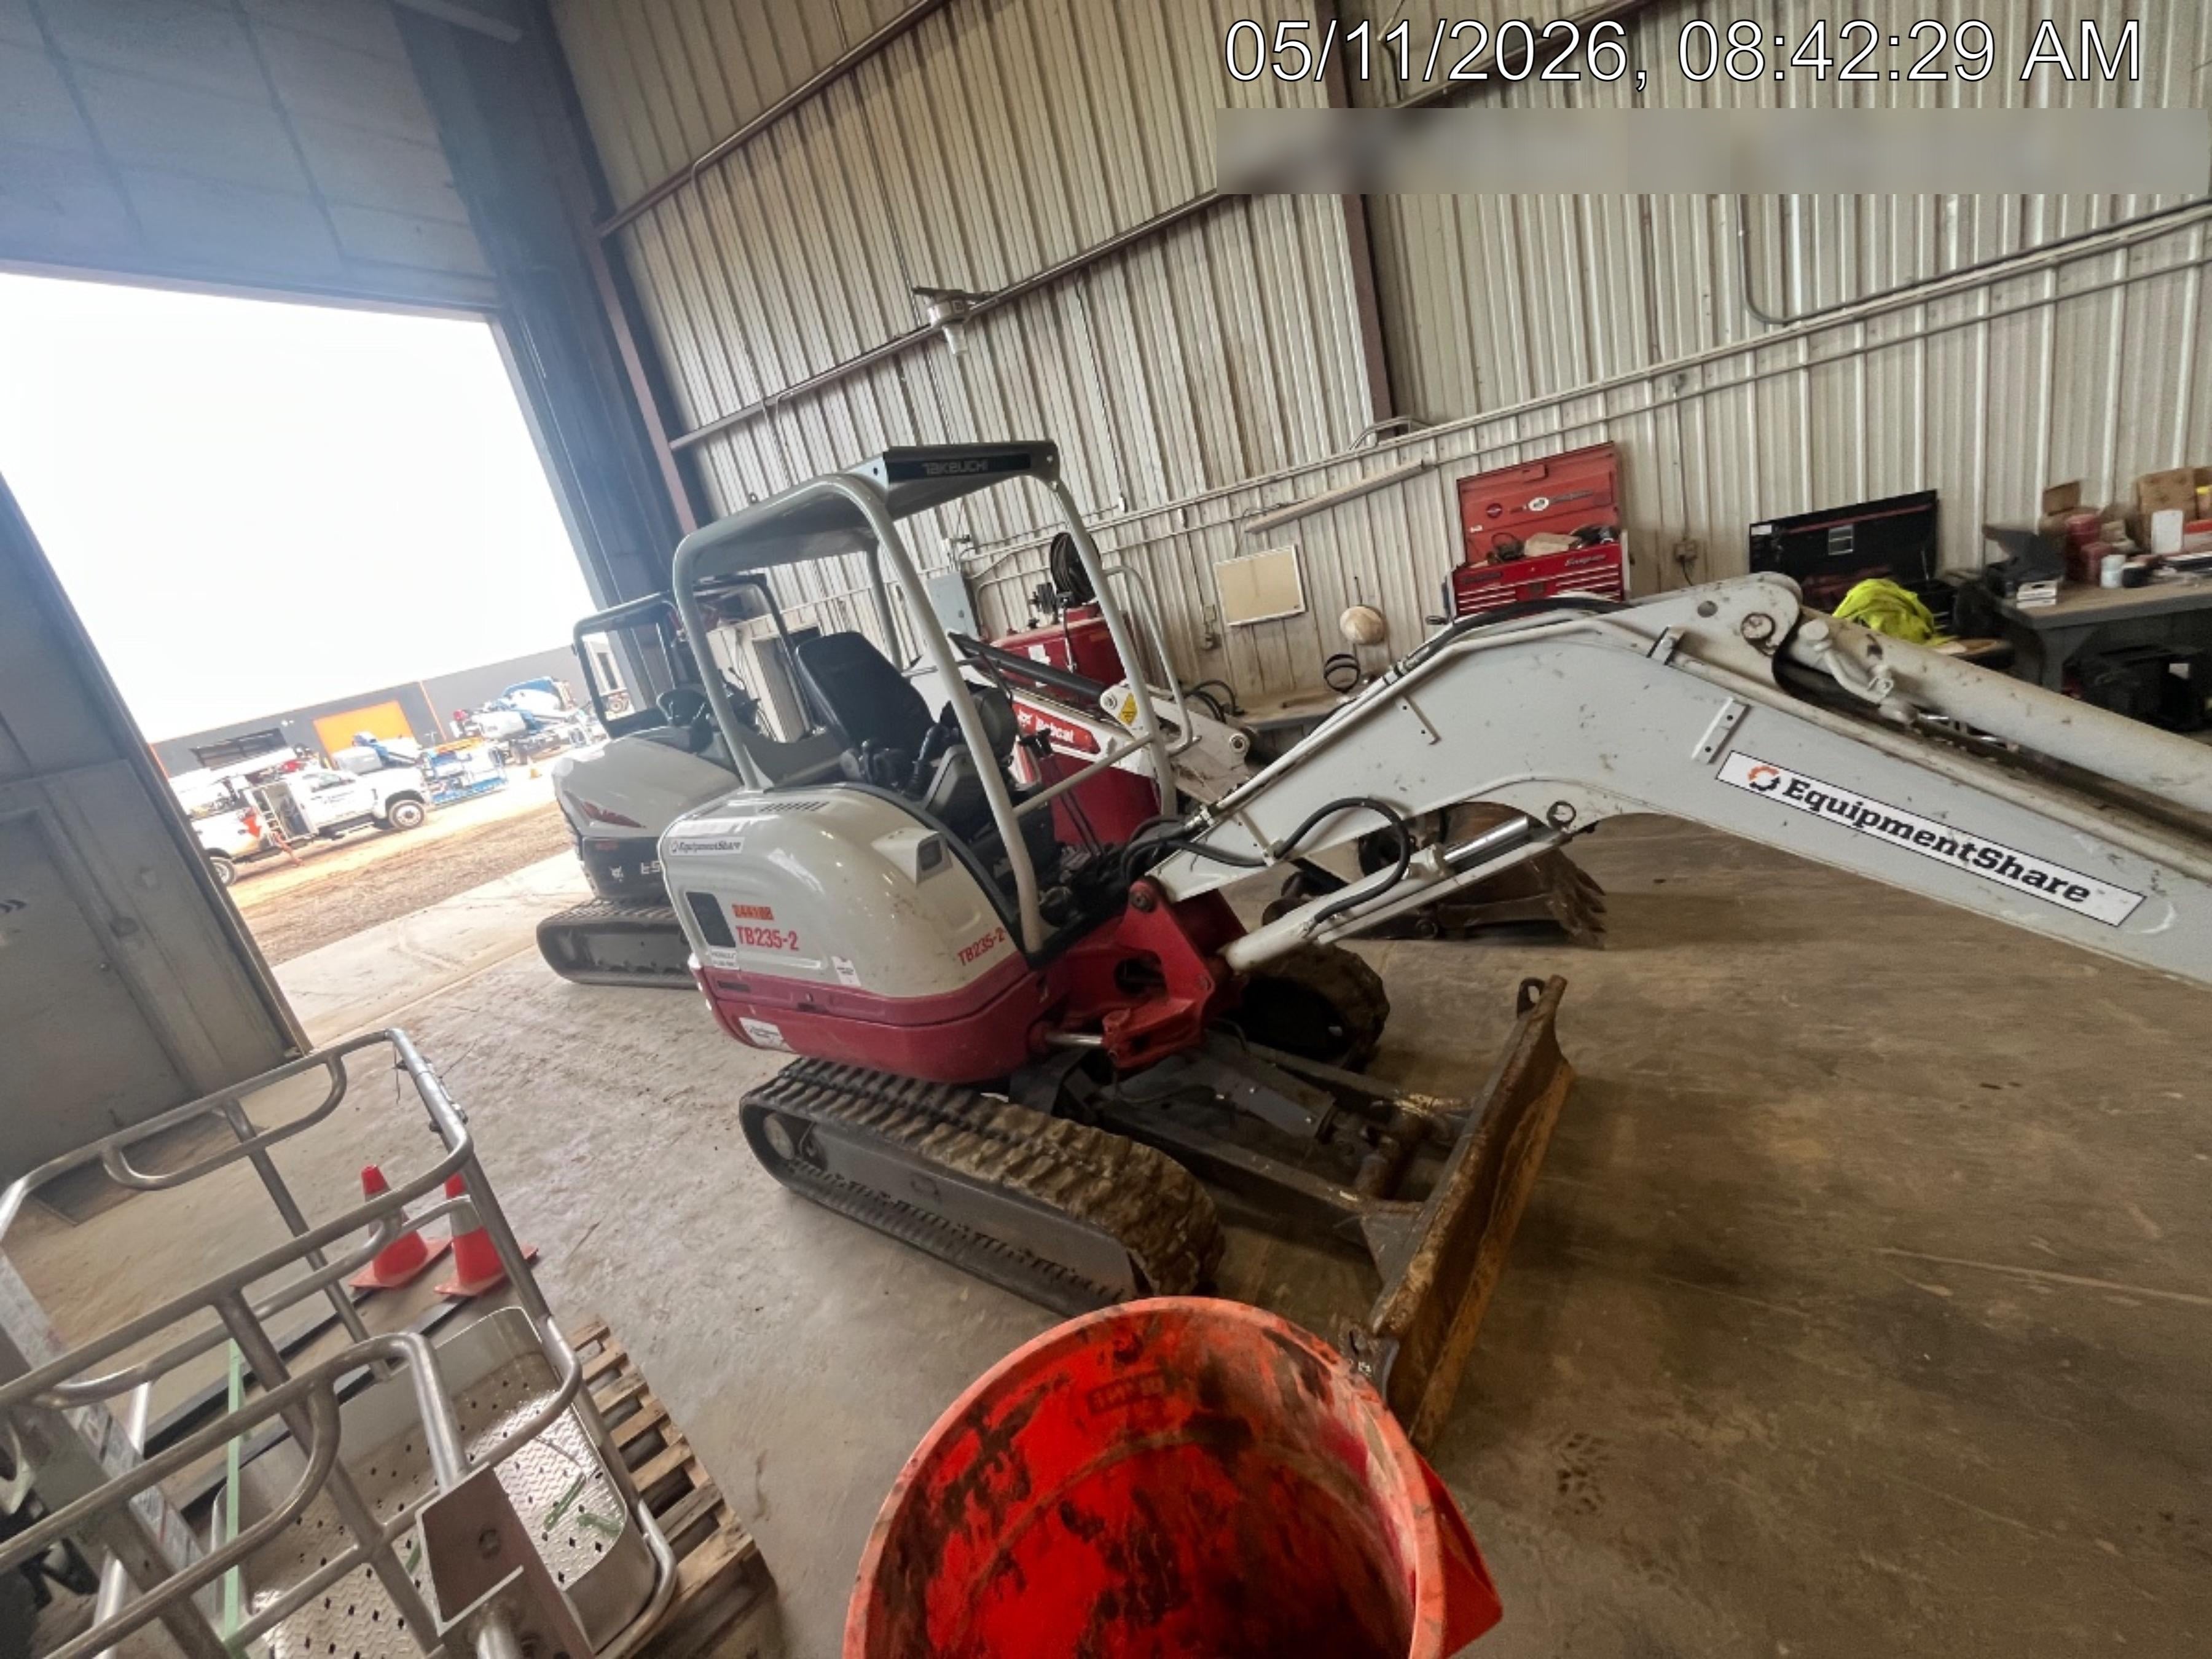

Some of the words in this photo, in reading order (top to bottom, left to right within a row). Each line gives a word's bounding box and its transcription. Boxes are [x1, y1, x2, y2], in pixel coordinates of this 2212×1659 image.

[1782, 778, 2090, 903] EquipmentShare
[735, 925, 800, 952] TB235-2
[957, 927, 1006, 967] TB235-2
